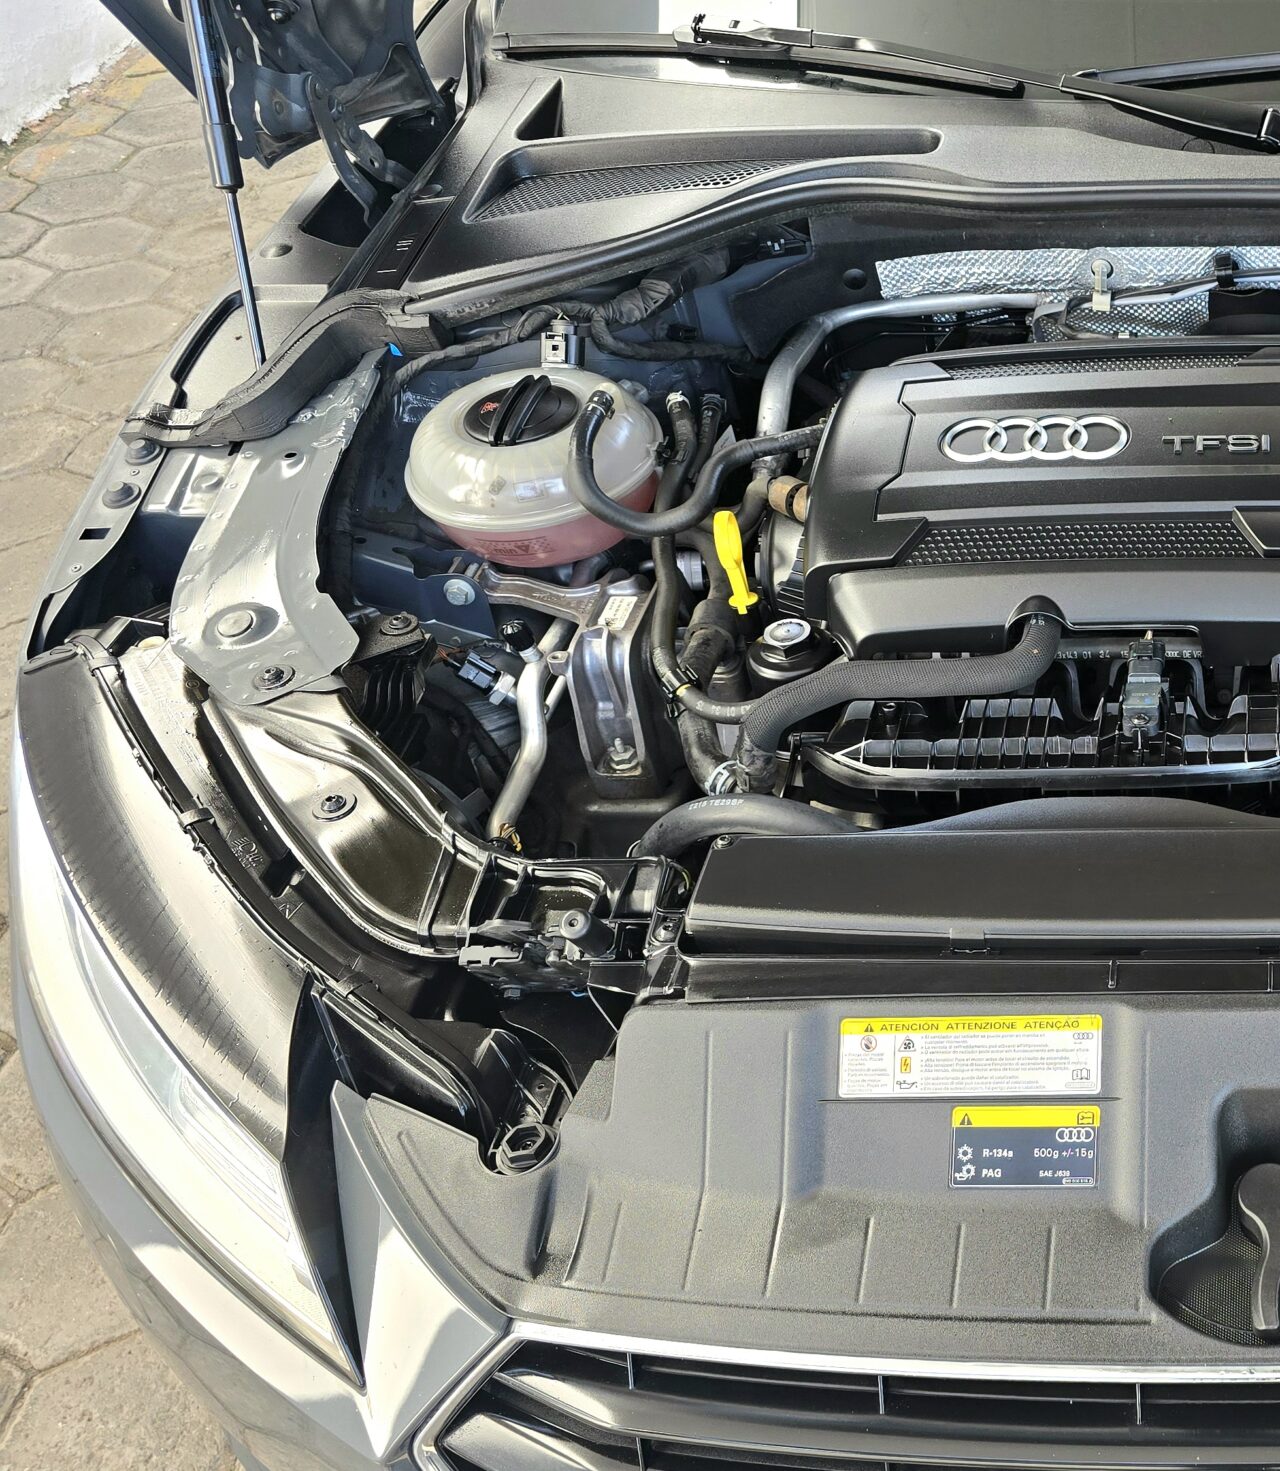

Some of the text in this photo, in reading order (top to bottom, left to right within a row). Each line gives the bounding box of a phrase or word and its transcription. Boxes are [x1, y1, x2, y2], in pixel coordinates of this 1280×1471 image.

[1161, 434, 1271, 453] TFSI
[945, 1021, 1017, 1031] ATTENZIONE
[982, 1148, 1014, 1158] R-134a
[1033, 1148, 1059, 1159] 500g
[981, 1168, 1002, 1178] PAG
